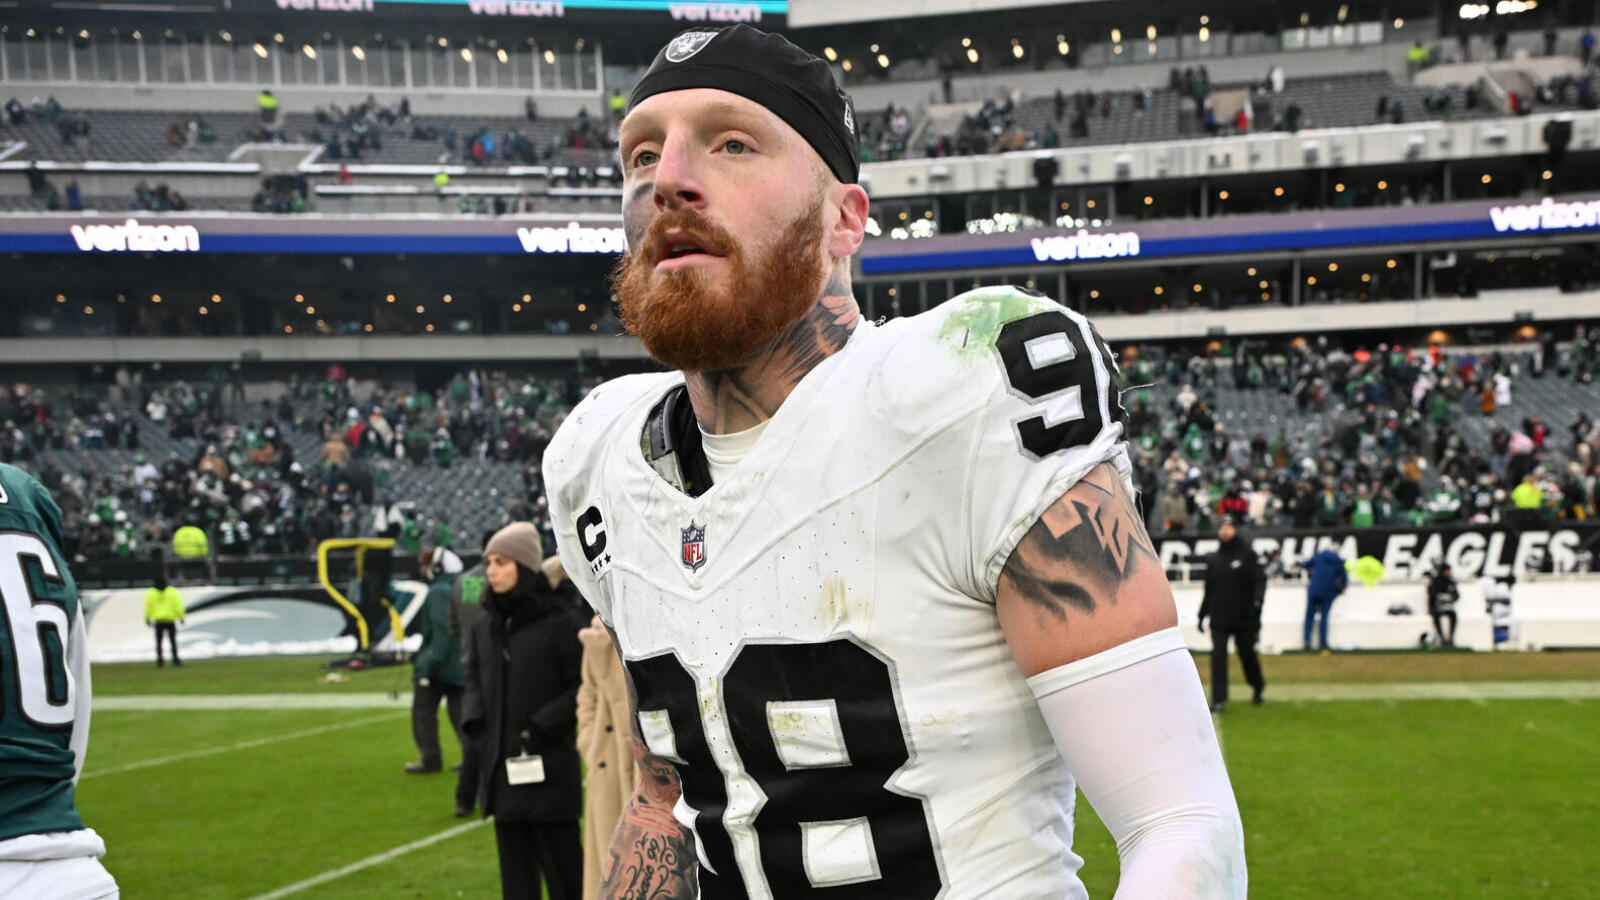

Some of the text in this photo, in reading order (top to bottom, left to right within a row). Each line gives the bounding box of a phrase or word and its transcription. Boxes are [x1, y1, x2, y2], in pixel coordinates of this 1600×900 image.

[467, 0, 574, 17] verizon
[668, 3, 763, 22] verizon
[70, 218, 200, 251] verizon
[1031, 229, 1140, 261] verizon
[576, 505, 607, 563] C
[683, 542, 702, 563] NFL
[1384, 529, 1580, 579] EAGLES
